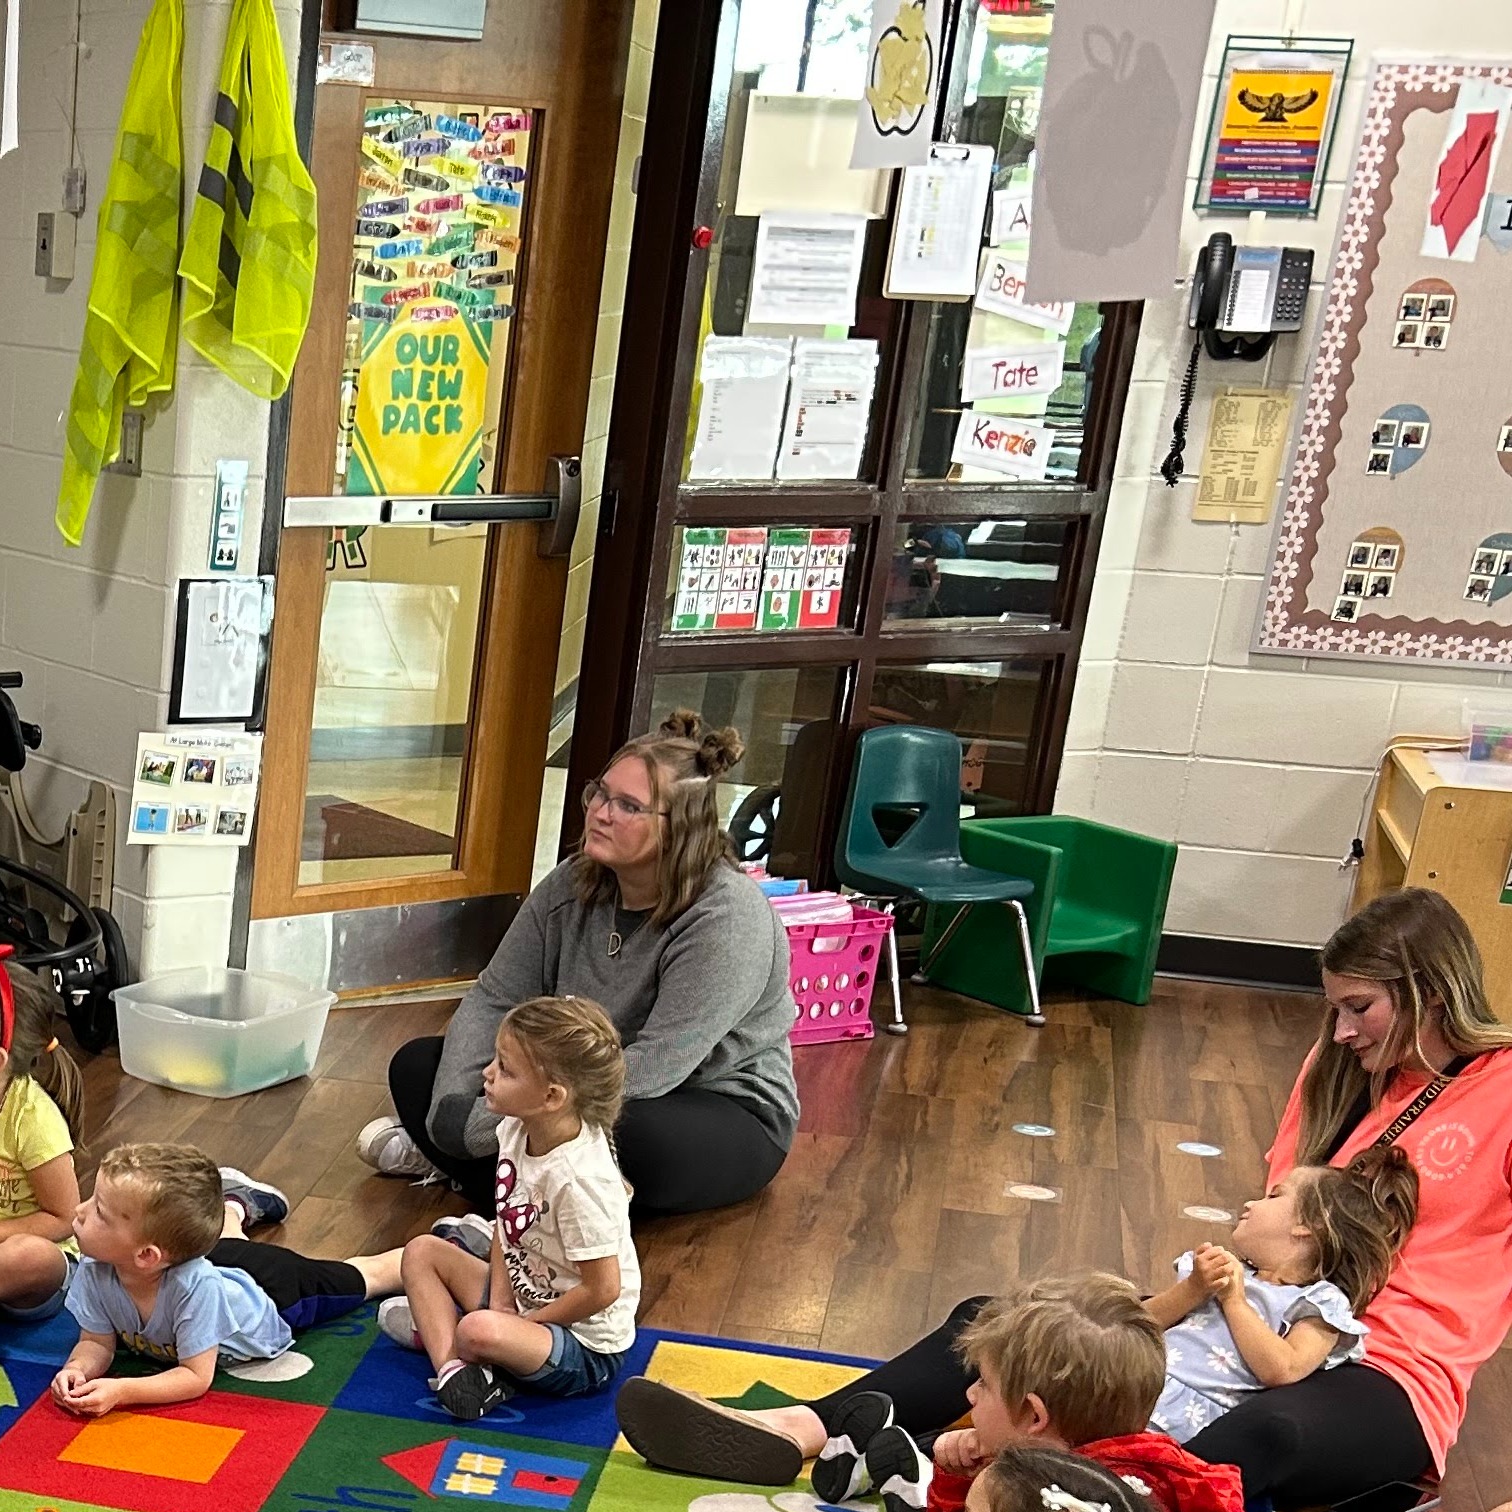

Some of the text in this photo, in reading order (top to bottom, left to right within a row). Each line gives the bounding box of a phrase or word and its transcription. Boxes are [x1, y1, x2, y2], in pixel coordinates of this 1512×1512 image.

[396, 332, 460, 367] OUR
[390, 367, 464, 402] NEW
[992, 360, 1039, 391] Tate
[382, 403, 464, 436] PACK
[972, 418, 1037, 458] Kenzie
